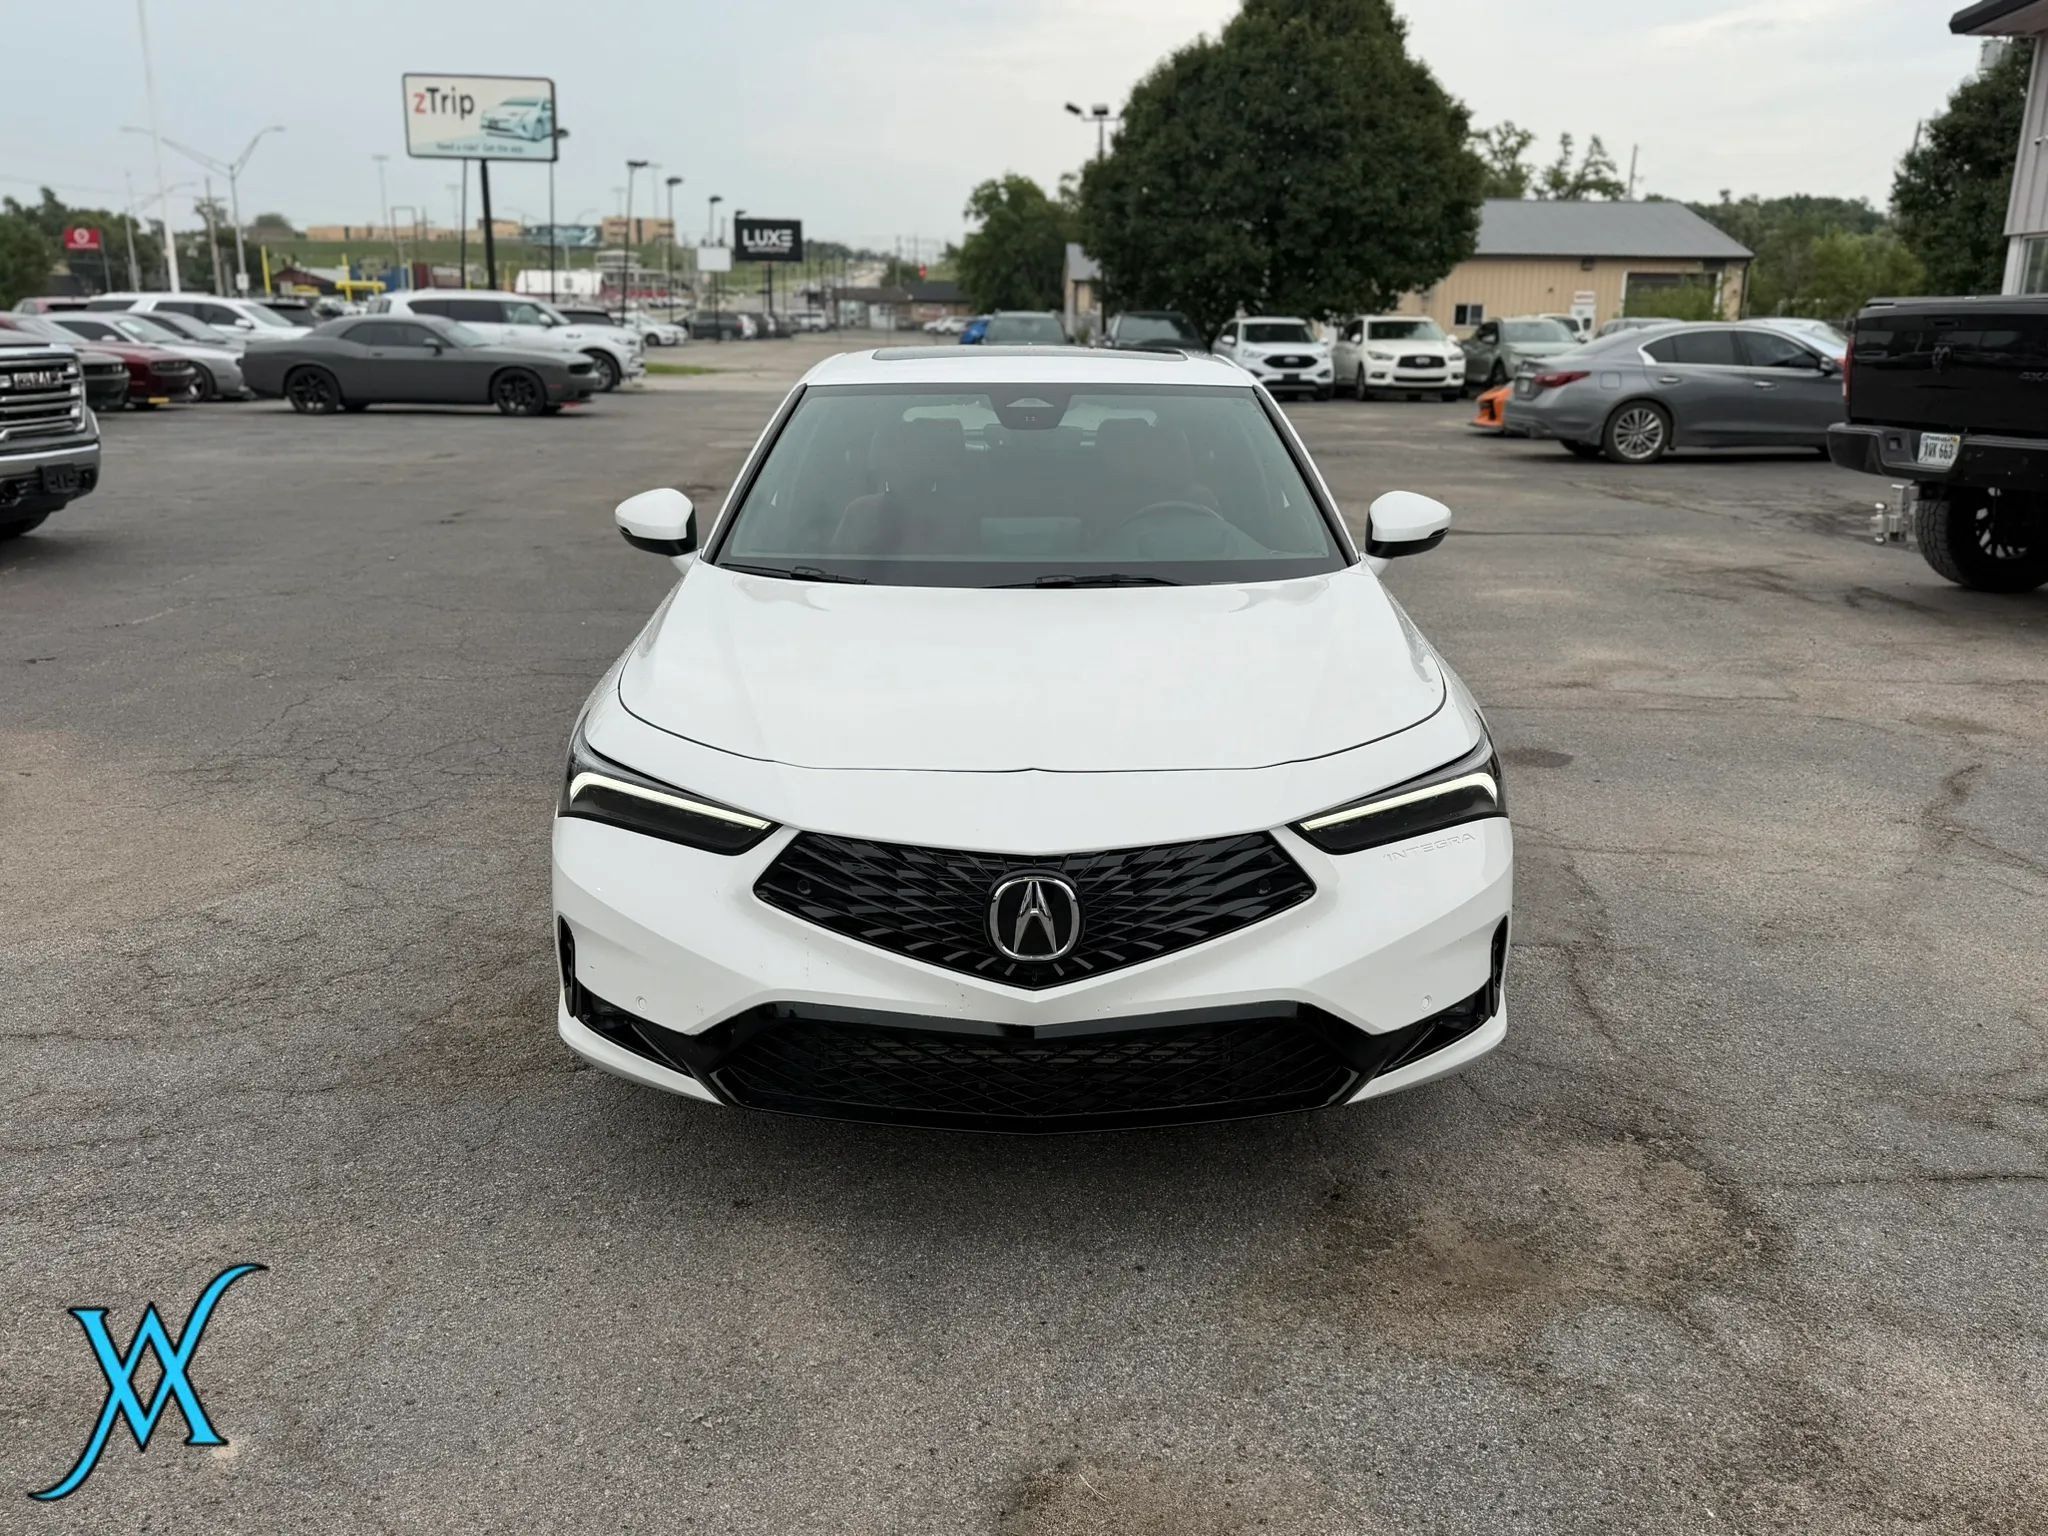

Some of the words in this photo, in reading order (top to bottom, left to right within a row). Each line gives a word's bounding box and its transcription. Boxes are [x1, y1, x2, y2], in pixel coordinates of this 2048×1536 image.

[413, 86, 475, 120] zTrip
[742, 228, 793, 248] LUXE
[1382, 832, 1476, 862] INTEGRA
